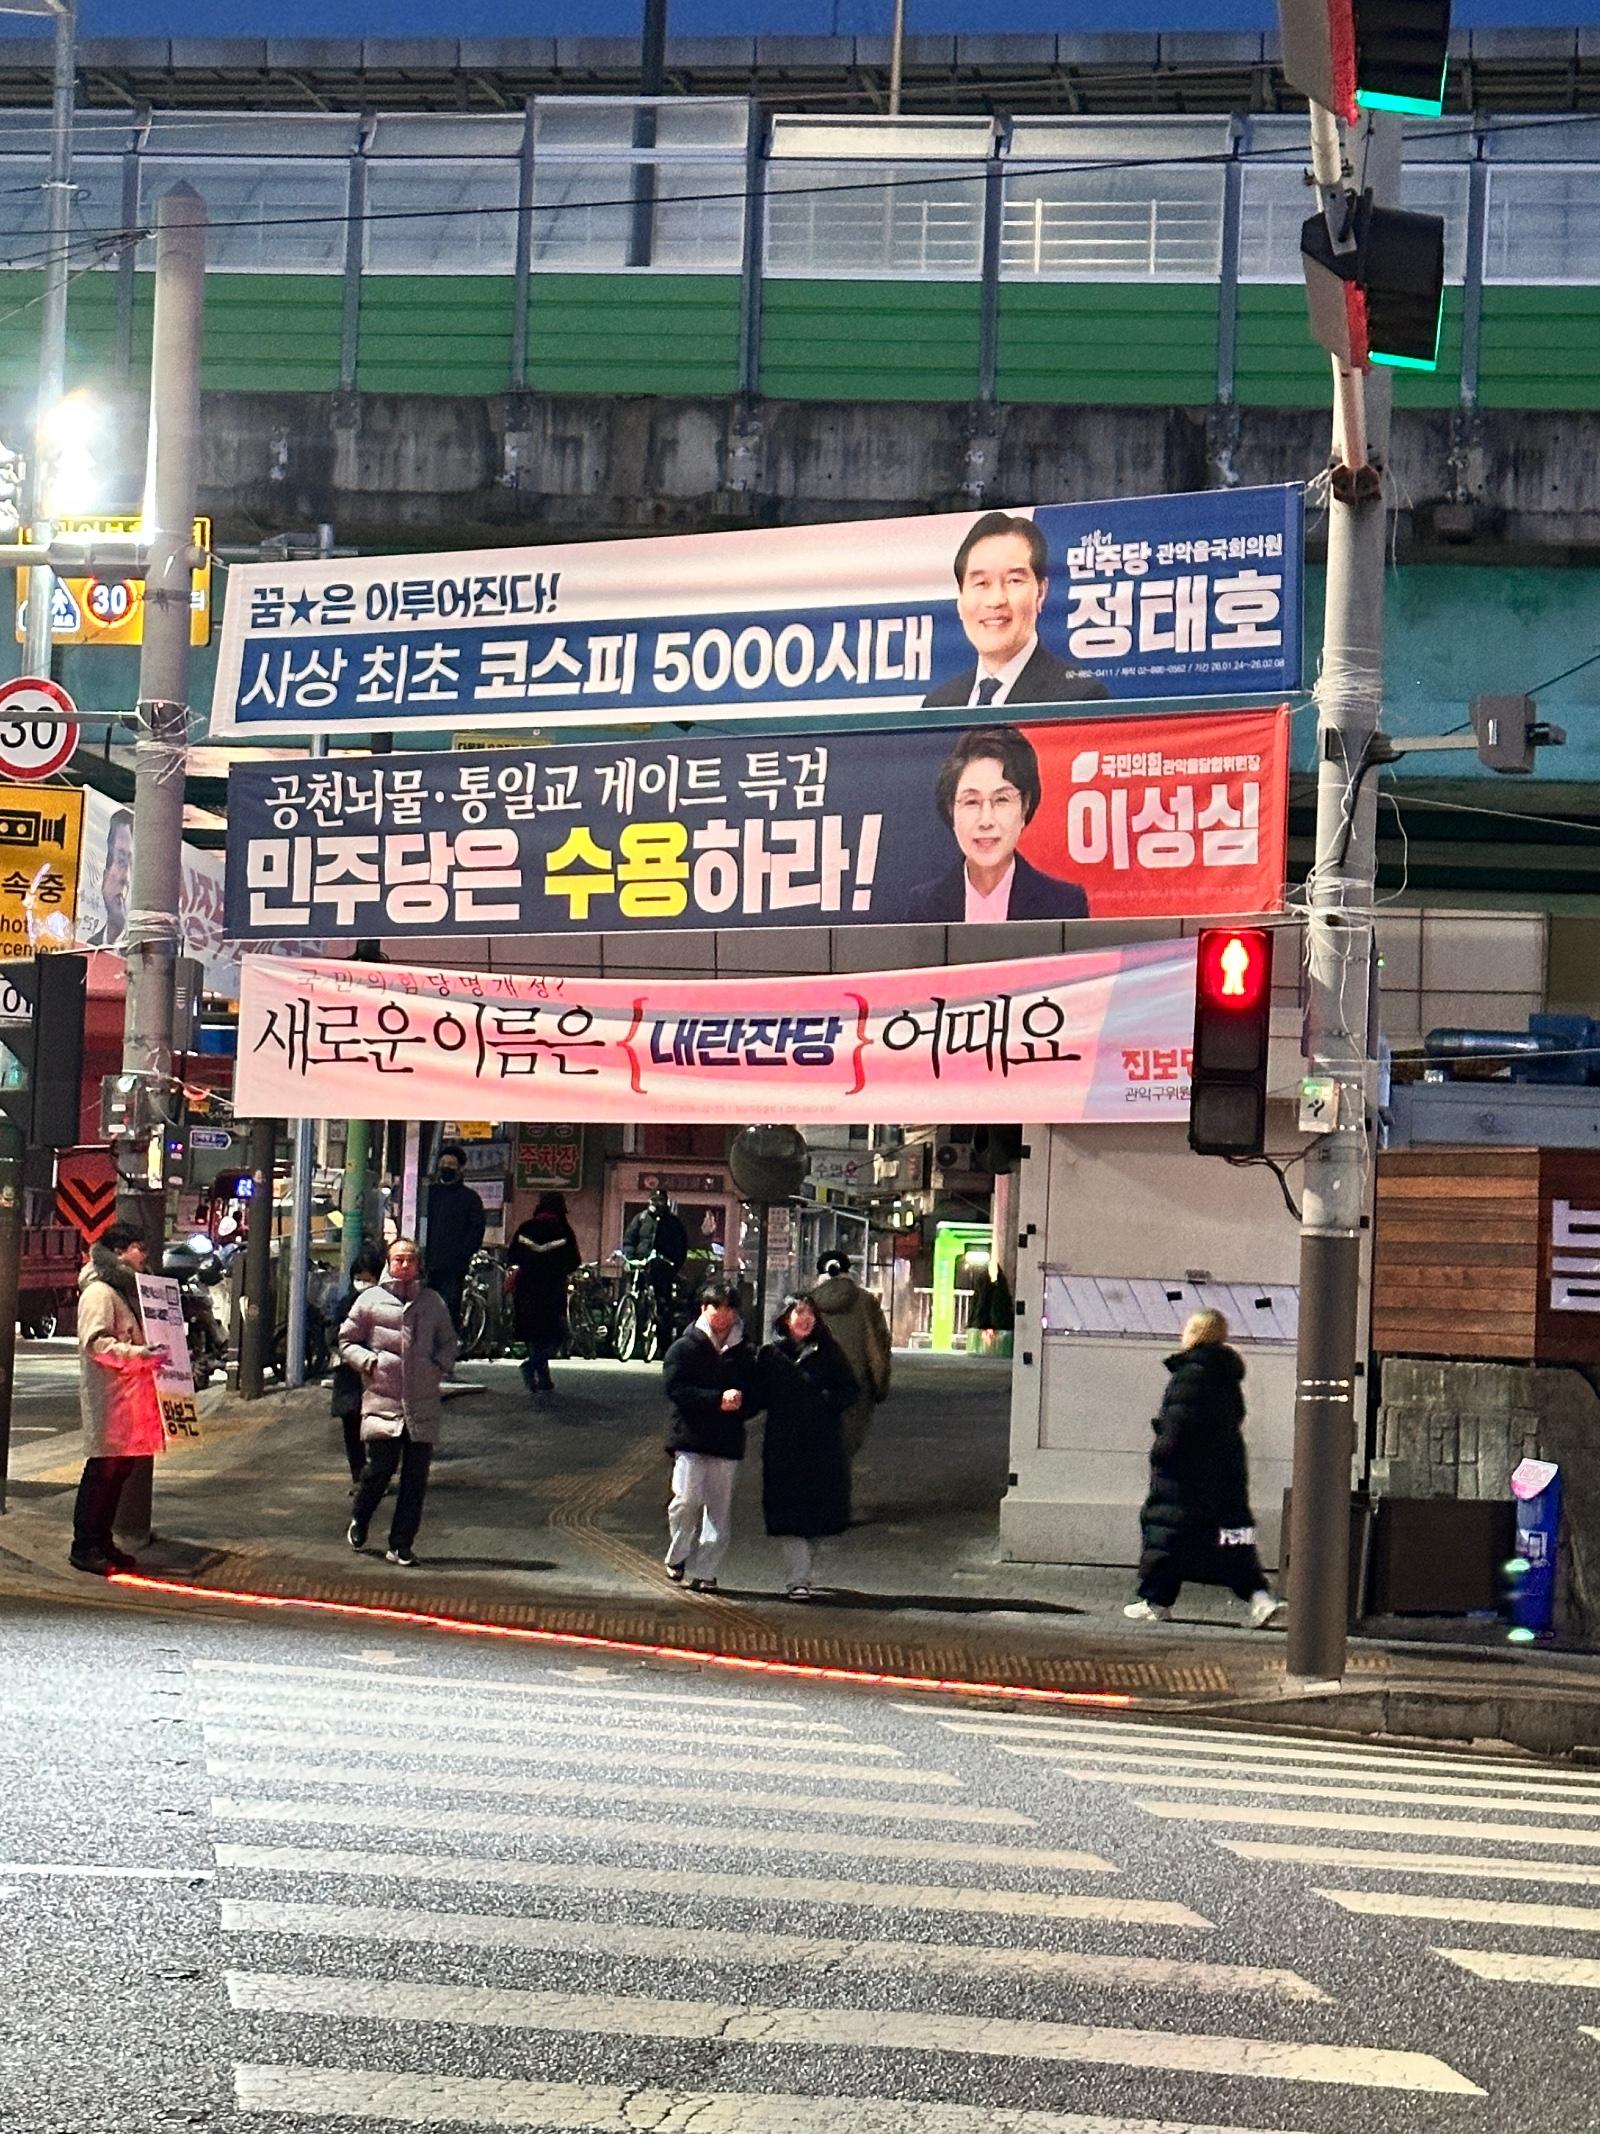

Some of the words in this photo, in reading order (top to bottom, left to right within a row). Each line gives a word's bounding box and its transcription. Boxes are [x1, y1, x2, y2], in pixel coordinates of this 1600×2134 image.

[1067, 541, 1152, 579] 민주당
[1156, 533, 1282, 565] 관악을국회의원
[93, 584, 127, 616] 30
[367, 572, 562, 621] 이루어진다!
[1067, 569, 1282, 659] 정태호
[241, 648, 348, 708] 사상
[356, 642, 460, 703] 최초
[474, 633, 639, 700] 코스피
[1, 705, 58, 750] 30
[599, 754, 727, 817] 게이트
[738, 747, 828, 811] 특검
[1101, 752, 1162, 779] 국민의힘
[1067, 782, 1260, 870] 이성심
[246, 827, 522, 926] 민주당은
[544, 814, 884, 921] 수용하라!
[298, 968, 419, 997] 국민의힘
[882, 993, 1081, 1079] 어때요
[519, 1143, 578, 1175] 주차장
